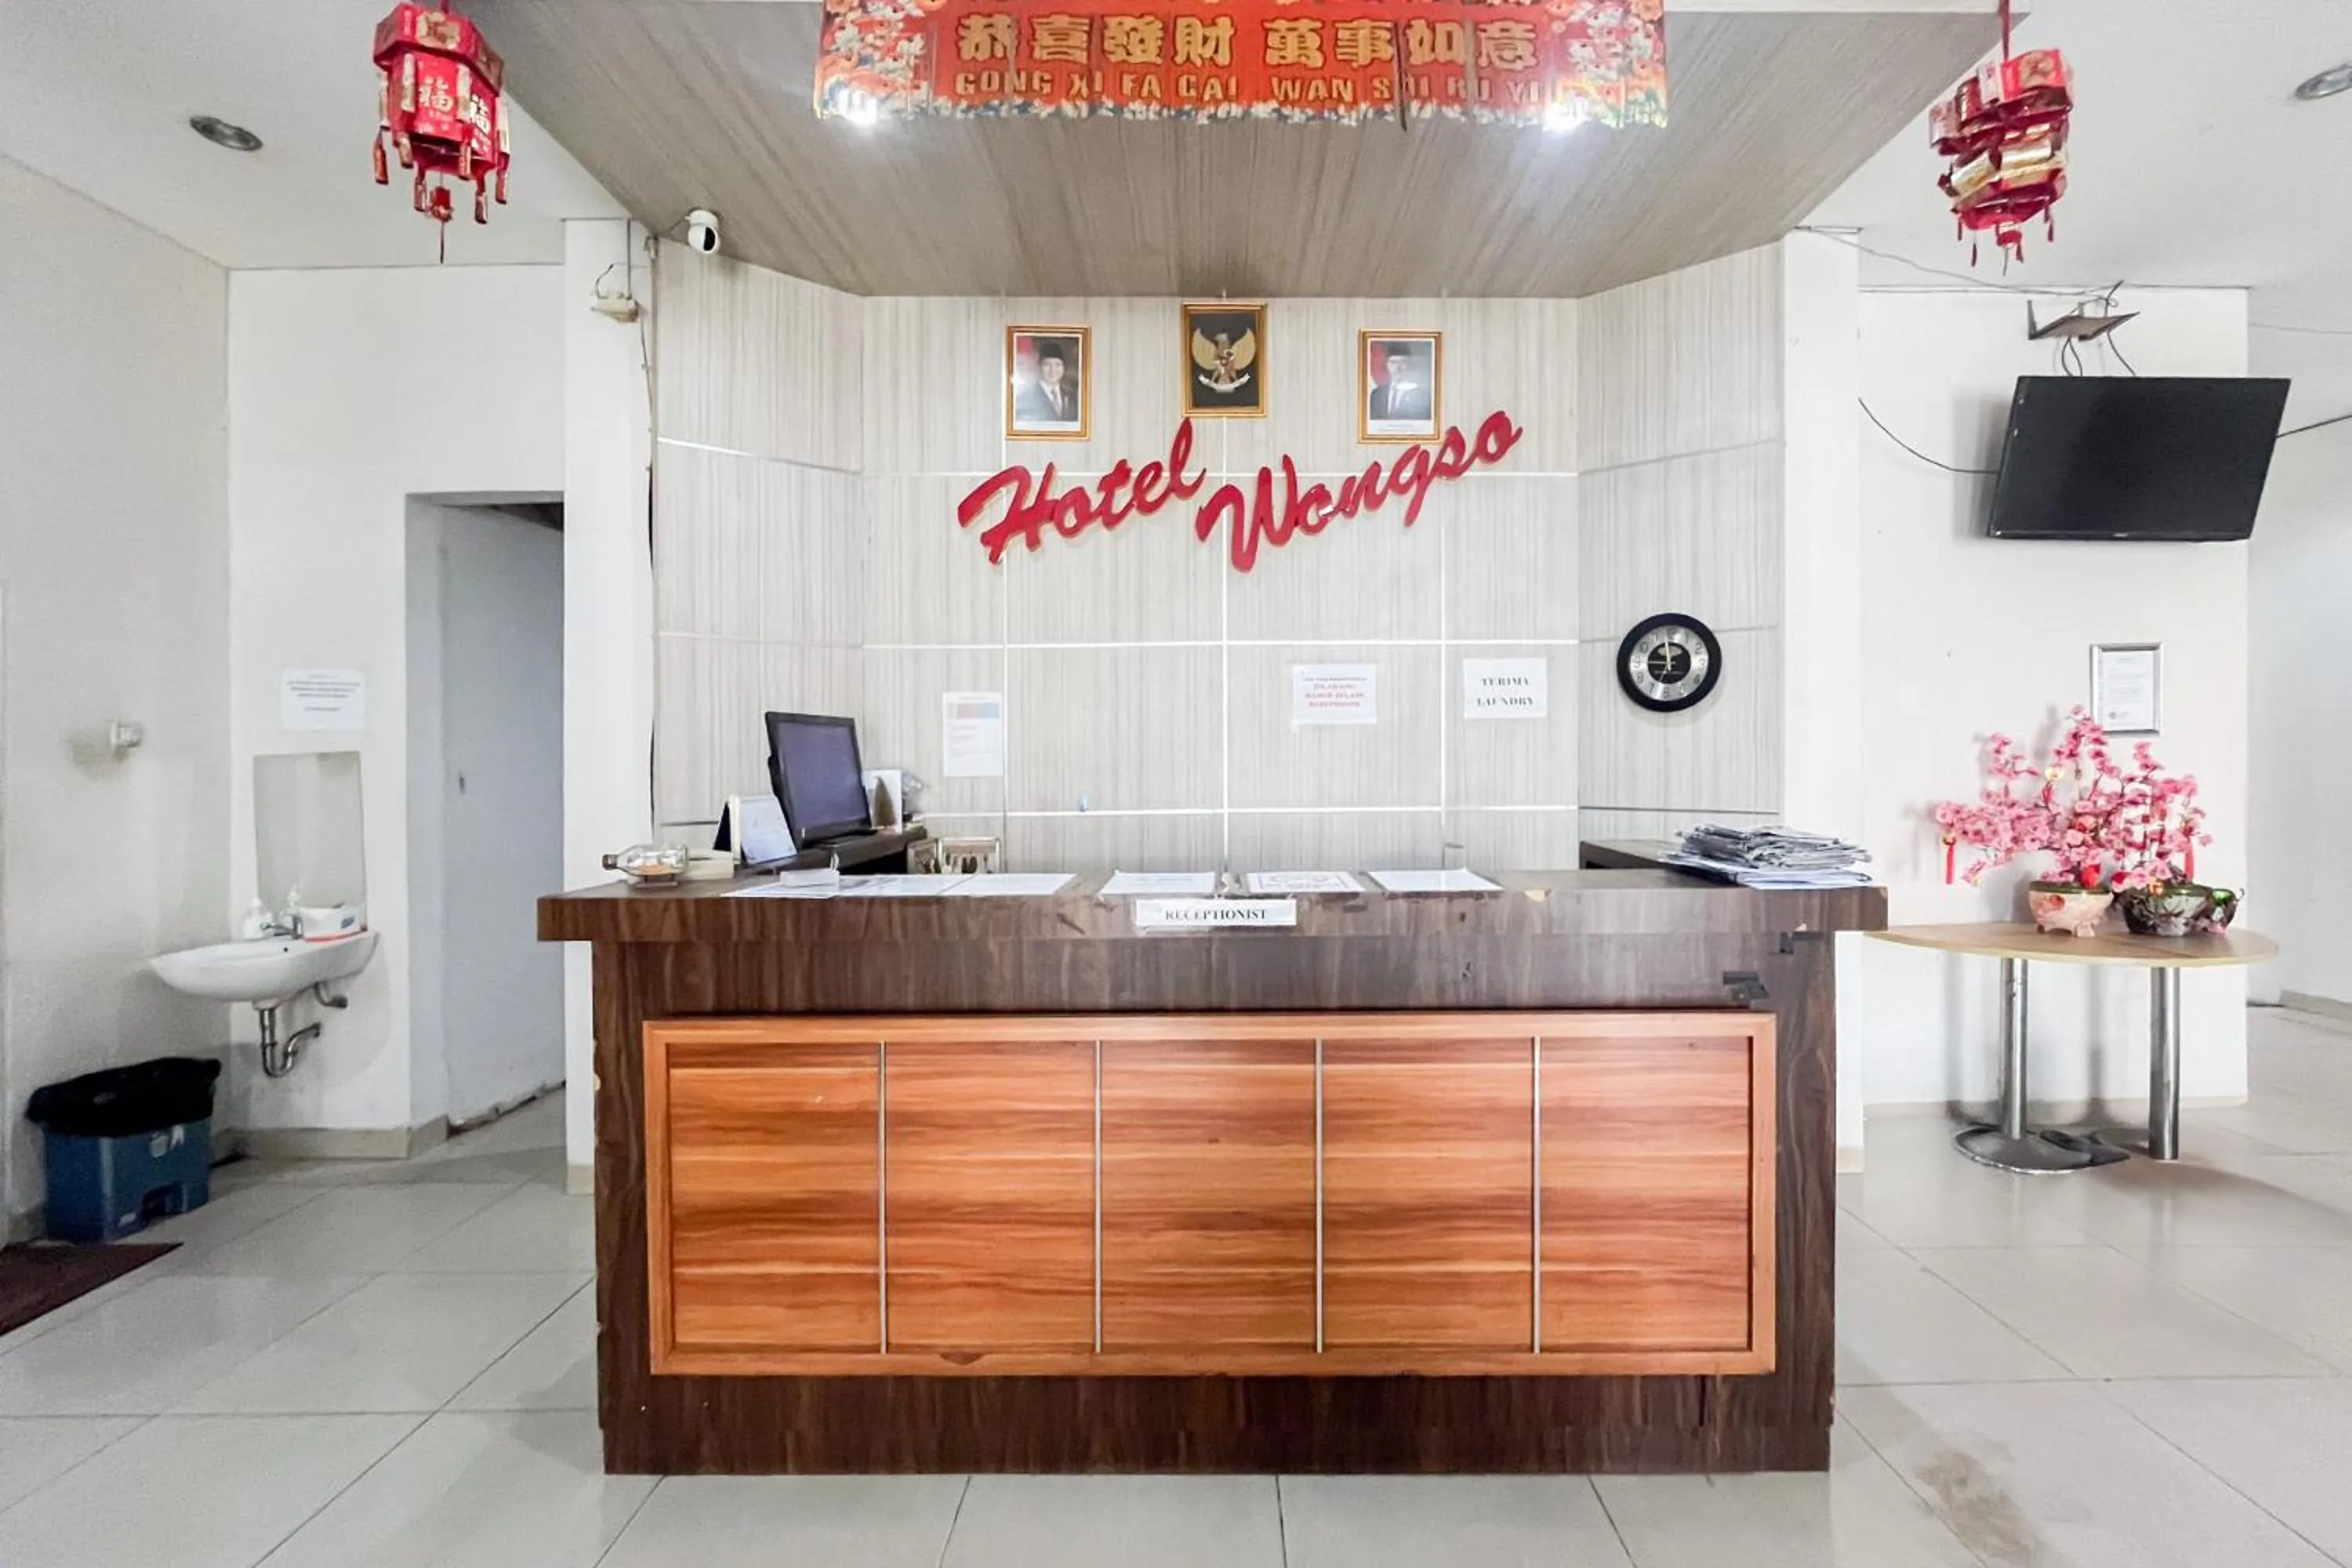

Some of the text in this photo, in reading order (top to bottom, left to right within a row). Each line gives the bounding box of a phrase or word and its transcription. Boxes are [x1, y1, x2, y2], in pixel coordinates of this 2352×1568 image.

[1262, 18, 1539, 70] 萬事如意
[956, 70, 1052, 96] GONG
[1069, 71, 1103, 98] XI
[1121, 73, 1162, 100] FA
[1178, 74, 1238, 101] CAI
[1271, 76, 1353, 103] WAN
[1507, 80, 1540, 103] YI
[957, 410, 1523, 572] Hotel Wongso
[1480, 677, 1529, 686] TERIMA
[1476, 697, 1534, 706] LAUNDRY
[1165, 909, 1267, 920] RECEPTIONIST
